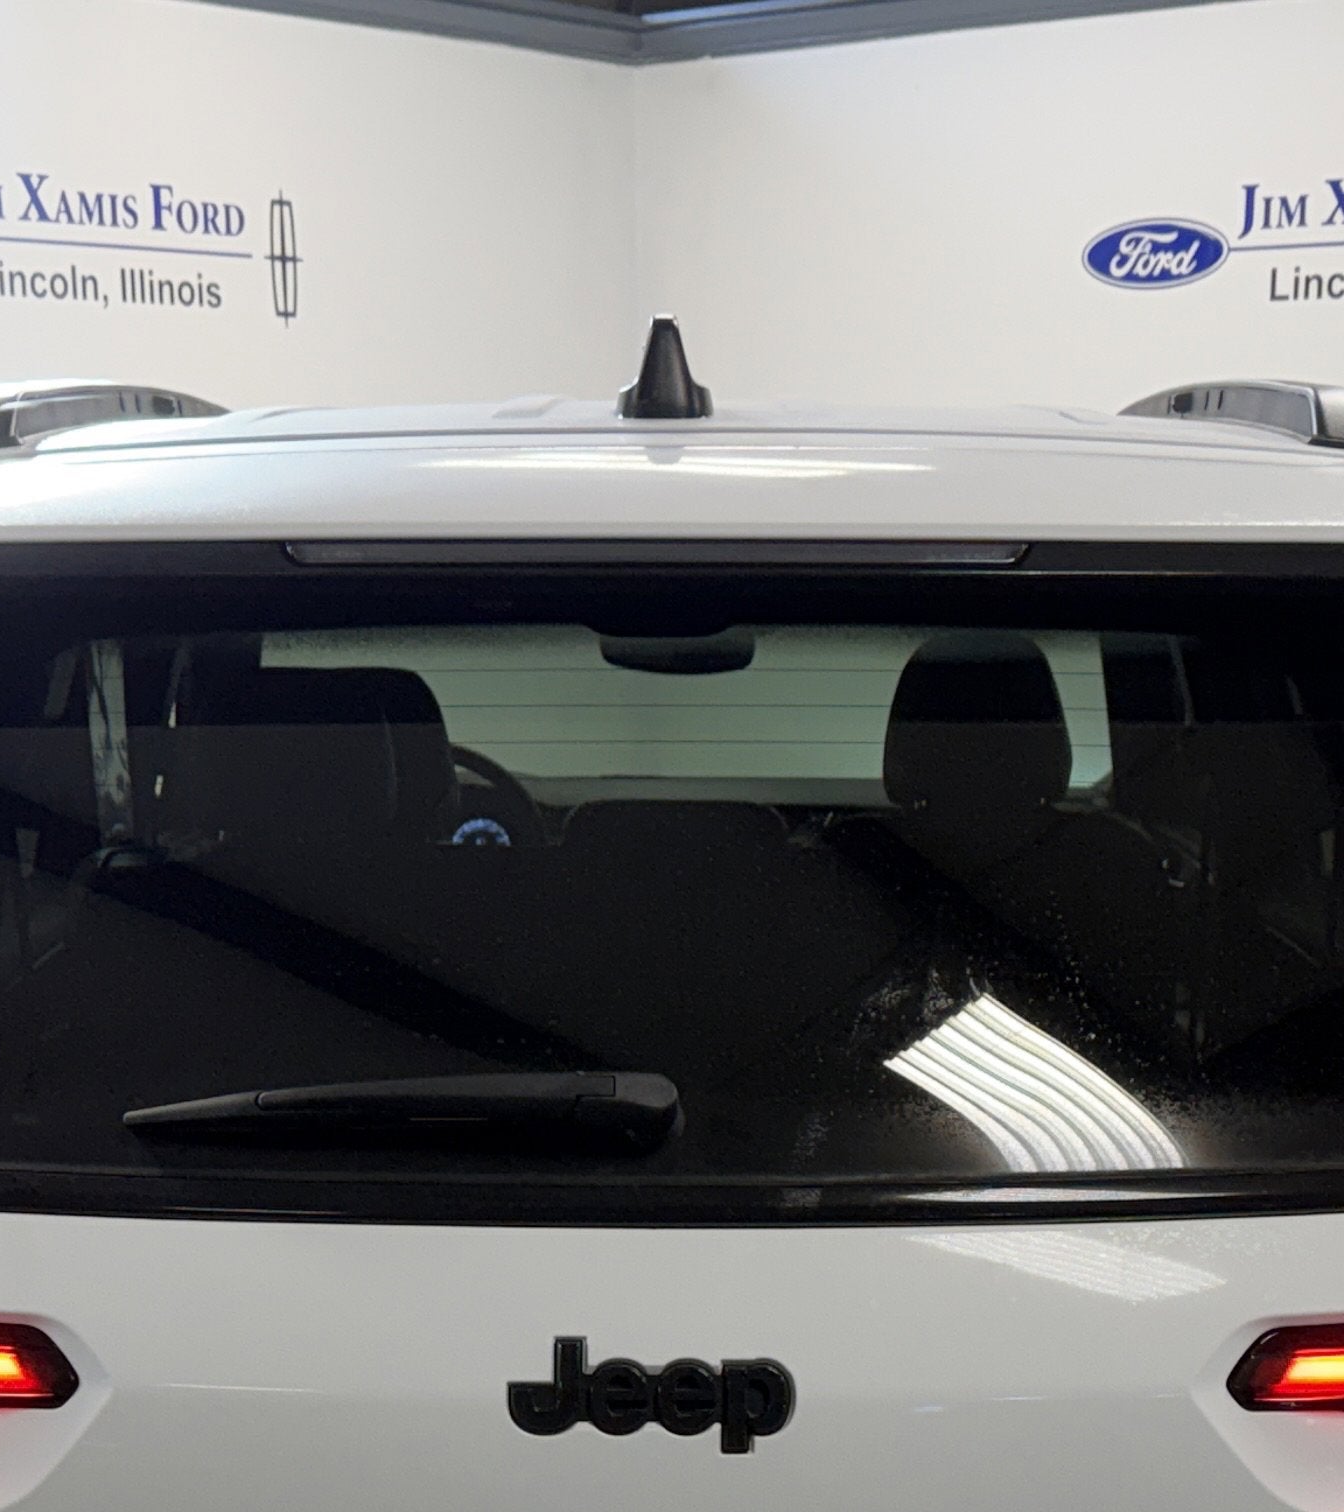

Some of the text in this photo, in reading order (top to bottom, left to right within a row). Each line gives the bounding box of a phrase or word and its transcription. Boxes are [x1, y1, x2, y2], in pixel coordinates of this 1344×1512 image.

[15, 171, 140, 230] XAMIS
[148, 183, 246, 238] FORD
[1238, 183, 1309, 240] JIM
[1108, 229, 1198, 279] Ford
[119, 267, 223, 309] Illinois
[507, 1336, 796, 1454] Jeep
